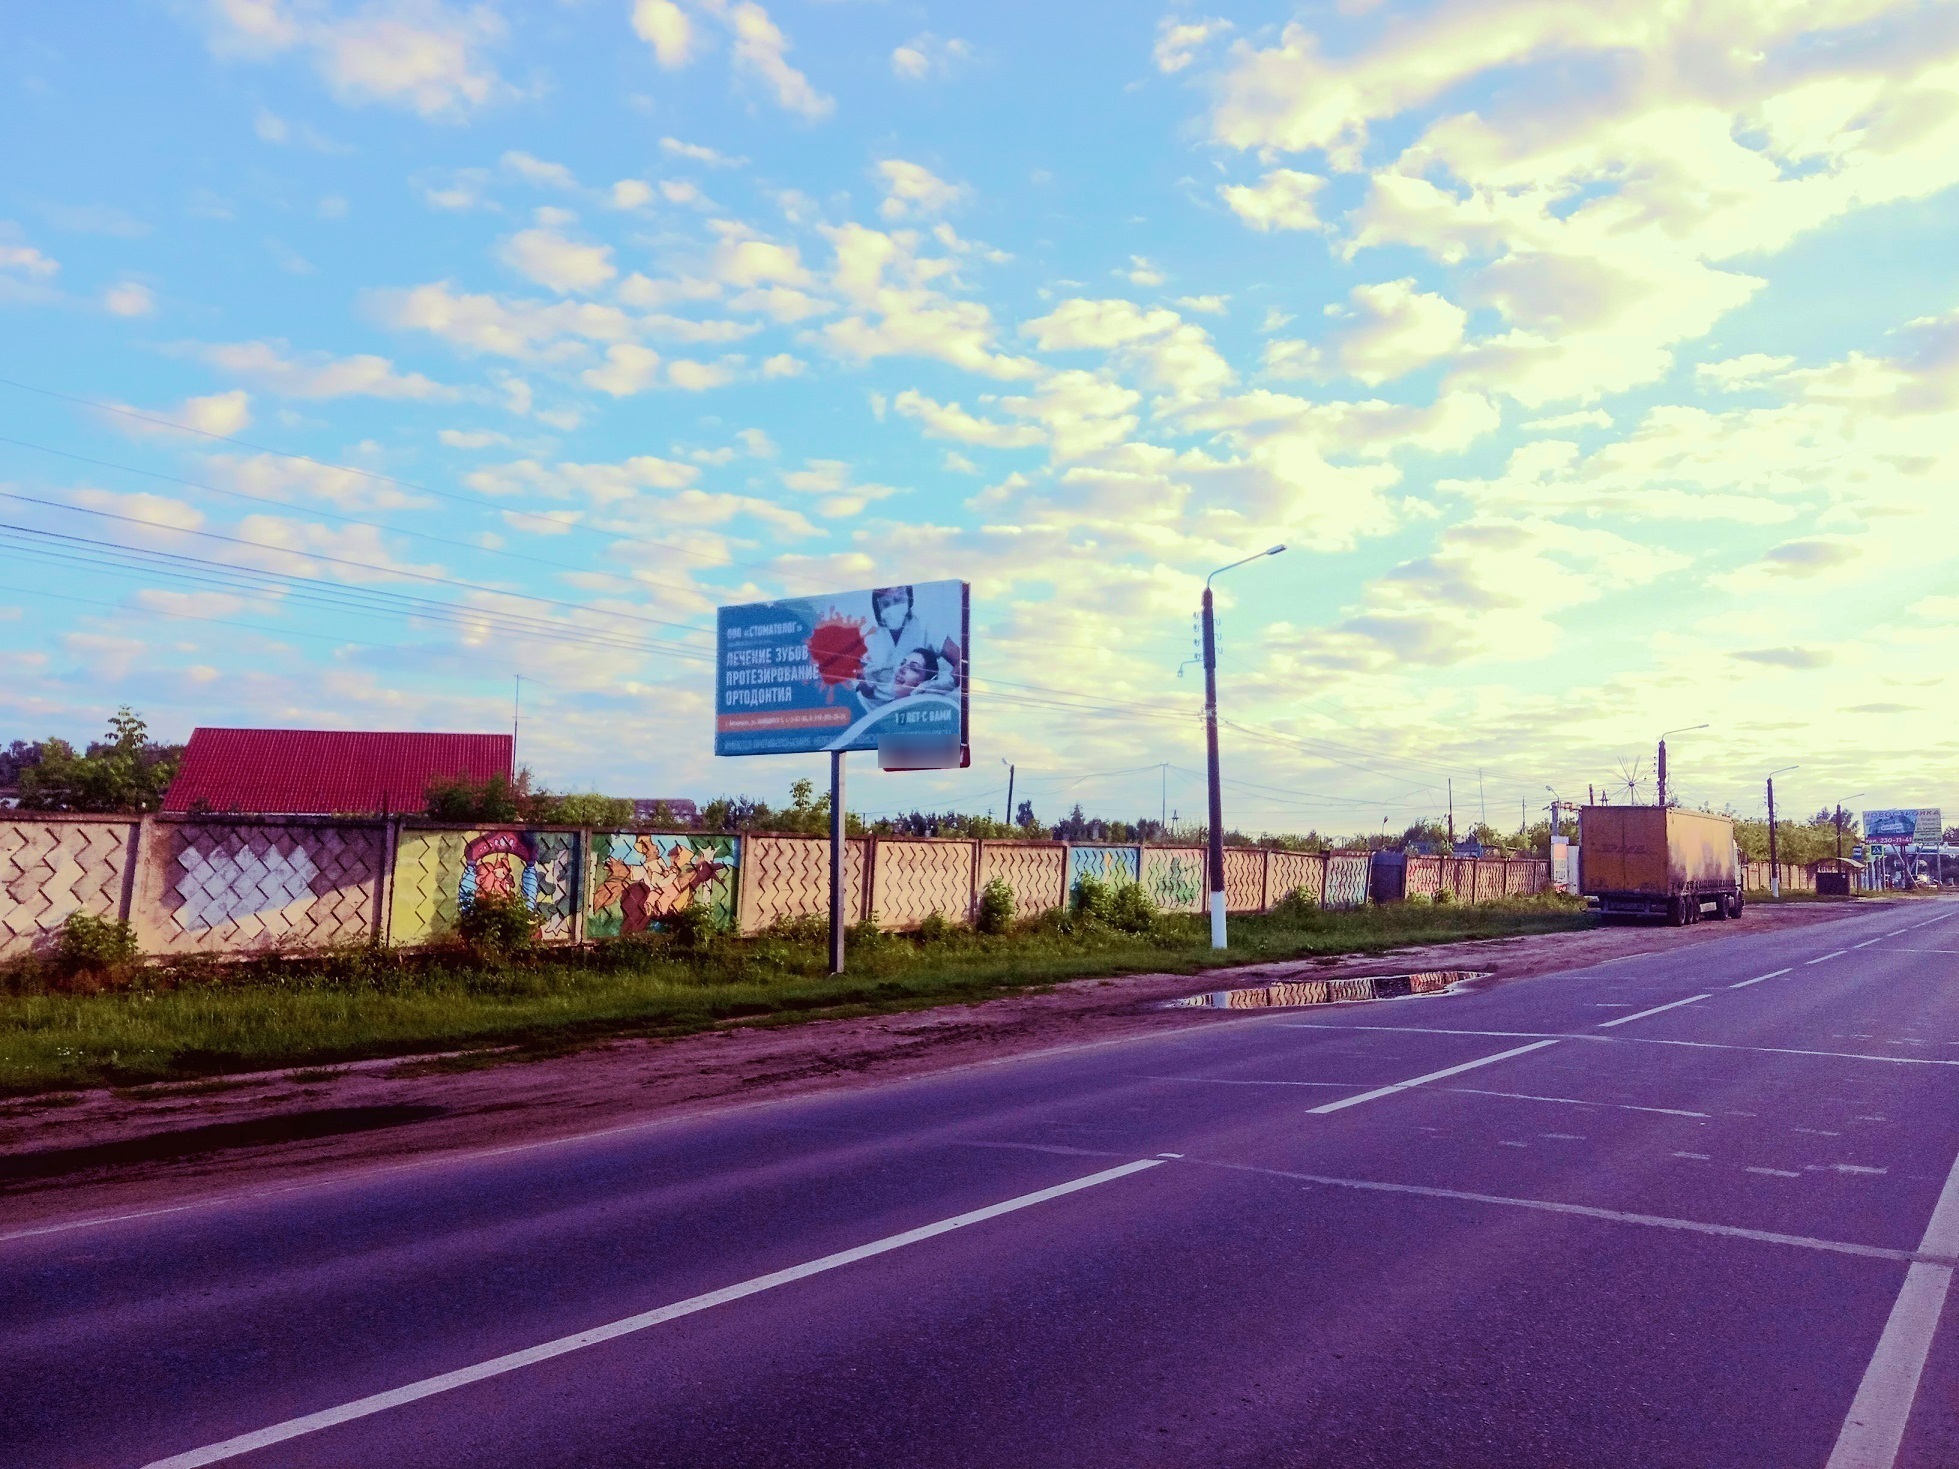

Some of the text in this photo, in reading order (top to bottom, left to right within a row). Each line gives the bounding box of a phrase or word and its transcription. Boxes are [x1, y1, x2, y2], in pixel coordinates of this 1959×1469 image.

[726, 645, 809, 667] ЛЕЧЕНИЕ ЗУБОВ
[726, 664, 820, 686] ПРОТЕЗИРОВАНИЕ
[725, 686, 792, 707] ОРТОДОНТИЯ
[929, 709, 952, 722] ВАМИ
